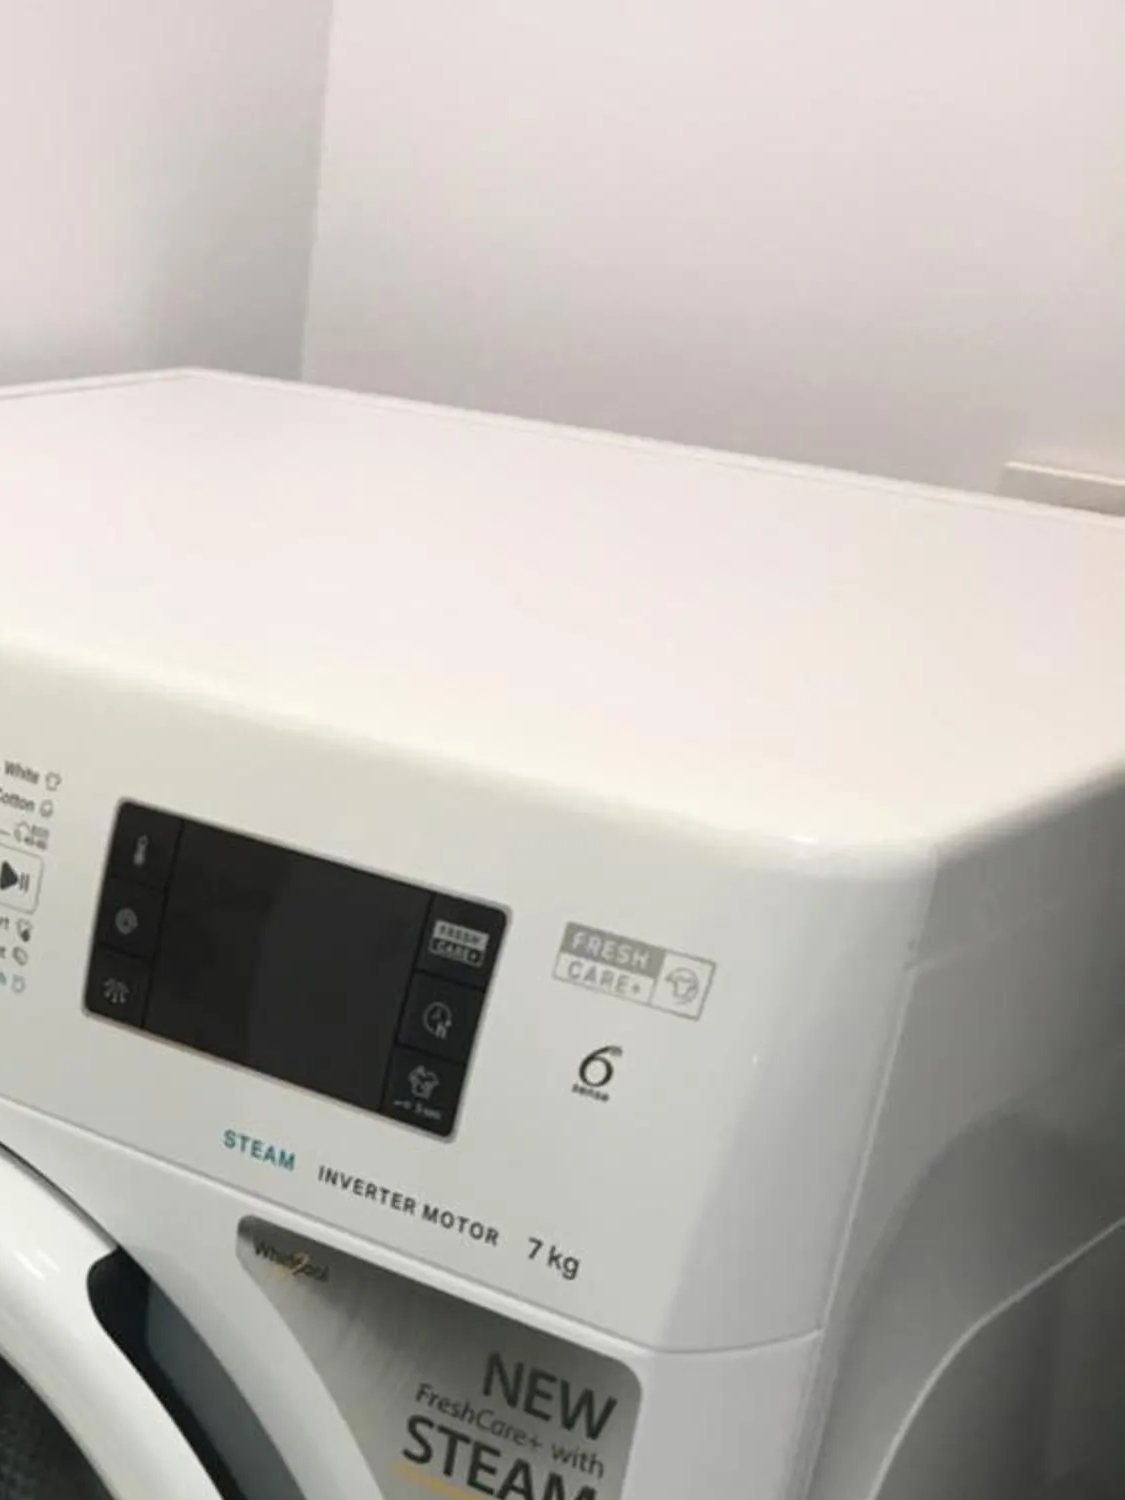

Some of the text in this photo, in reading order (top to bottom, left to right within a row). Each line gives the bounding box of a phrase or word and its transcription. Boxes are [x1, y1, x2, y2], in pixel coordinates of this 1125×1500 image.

[567, 960, 641, 995] CARE+
[571, 931, 651, 970] FRESH
[223, 1129, 581, 1280] STEAM INVERTER MOTOR 7 kg
[414, 1382, 605, 1479] FreshCare+ with
[482, 1350, 618, 1441] NEW
